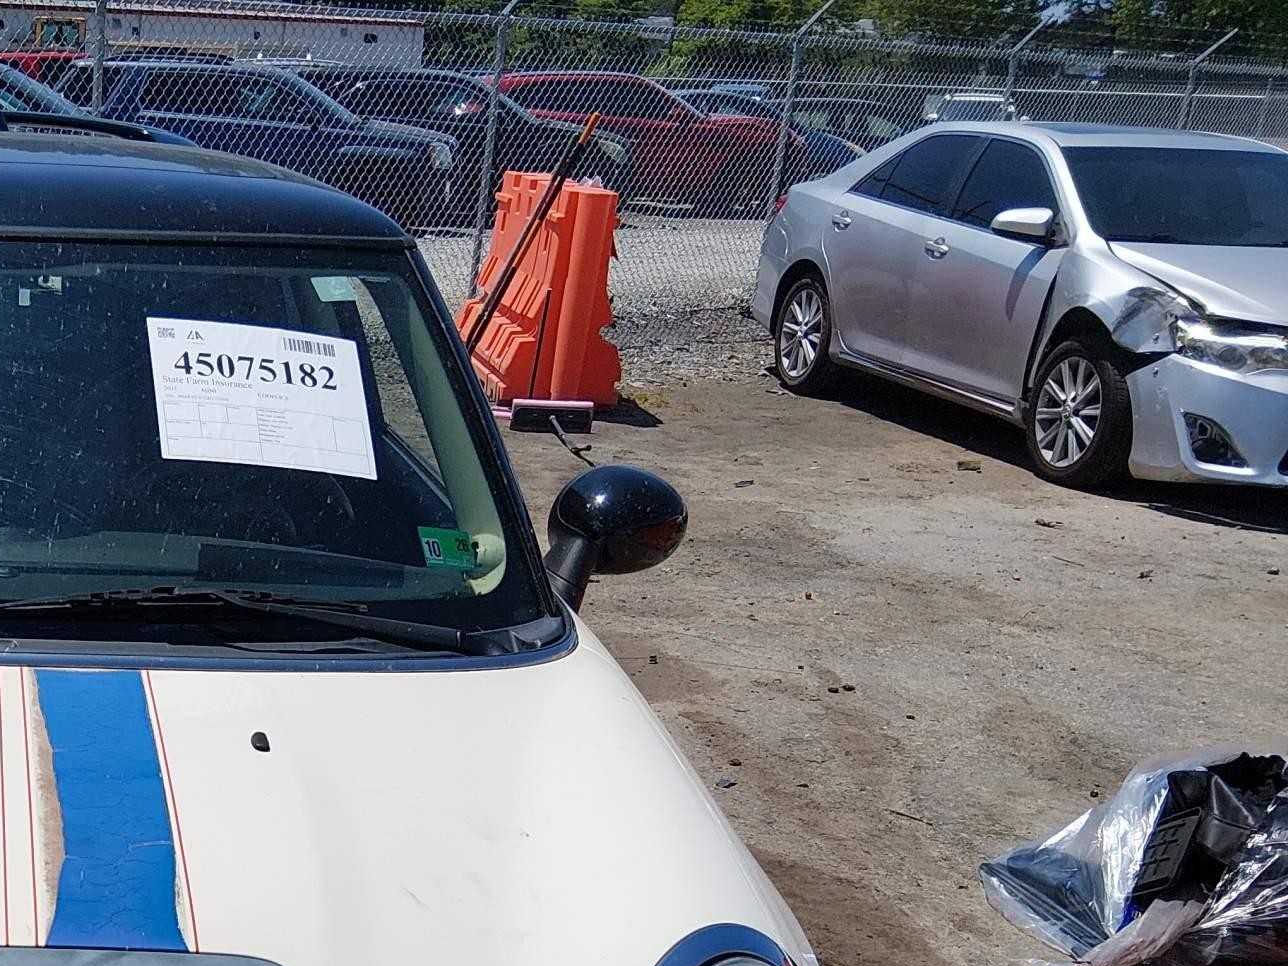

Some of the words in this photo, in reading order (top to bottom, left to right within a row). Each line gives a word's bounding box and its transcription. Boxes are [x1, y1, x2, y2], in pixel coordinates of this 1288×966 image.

[174, 351, 337, 391] 45075182
[162, 375, 184, 384] State
[211, 378, 254, 389] Insurance
[424, 540, 441, 557] 10
